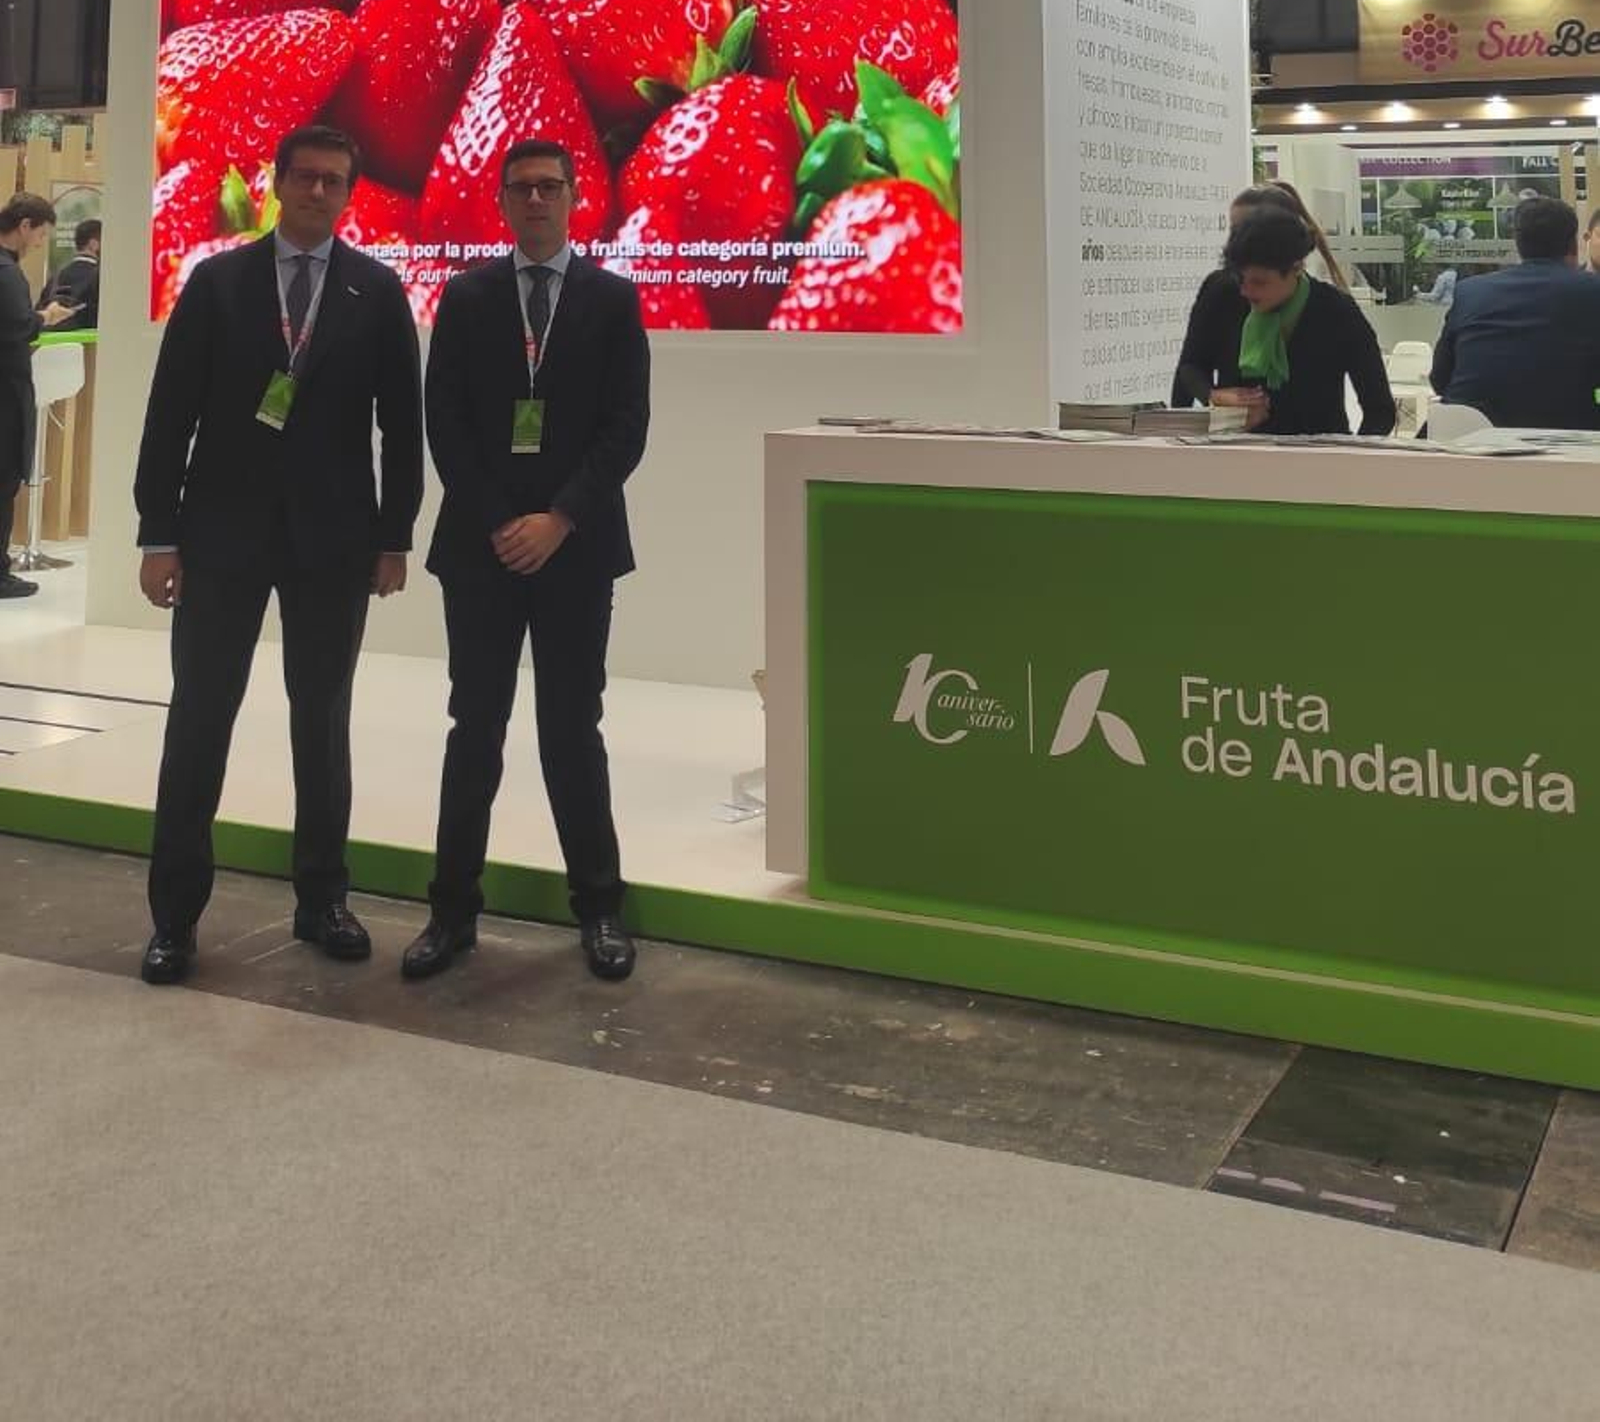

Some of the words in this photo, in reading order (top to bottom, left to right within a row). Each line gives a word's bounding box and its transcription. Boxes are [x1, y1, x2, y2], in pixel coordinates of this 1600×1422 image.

[1478, 19, 1600, 60] SurBe
[355, 242, 409, 259] estaca
[413, 243, 441, 261] por
[445, 241, 461, 257] la
[464, 239, 514, 259] produ
[591, 239, 646, 256] frutas
[650, 239, 673, 256] de
[678, 238, 767, 260] categoría
[771, 238, 866, 260] premium.
[629, 267, 672, 283] mium
[676, 267, 747, 288] category
[752, 266, 792, 284] fruit.
[1181, 676, 1329, 733] Fruta
[966, 710, 1015, 730] sario
[1181, 726, 1252, 776] de
[1273, 738, 1576, 813] Andalucía
